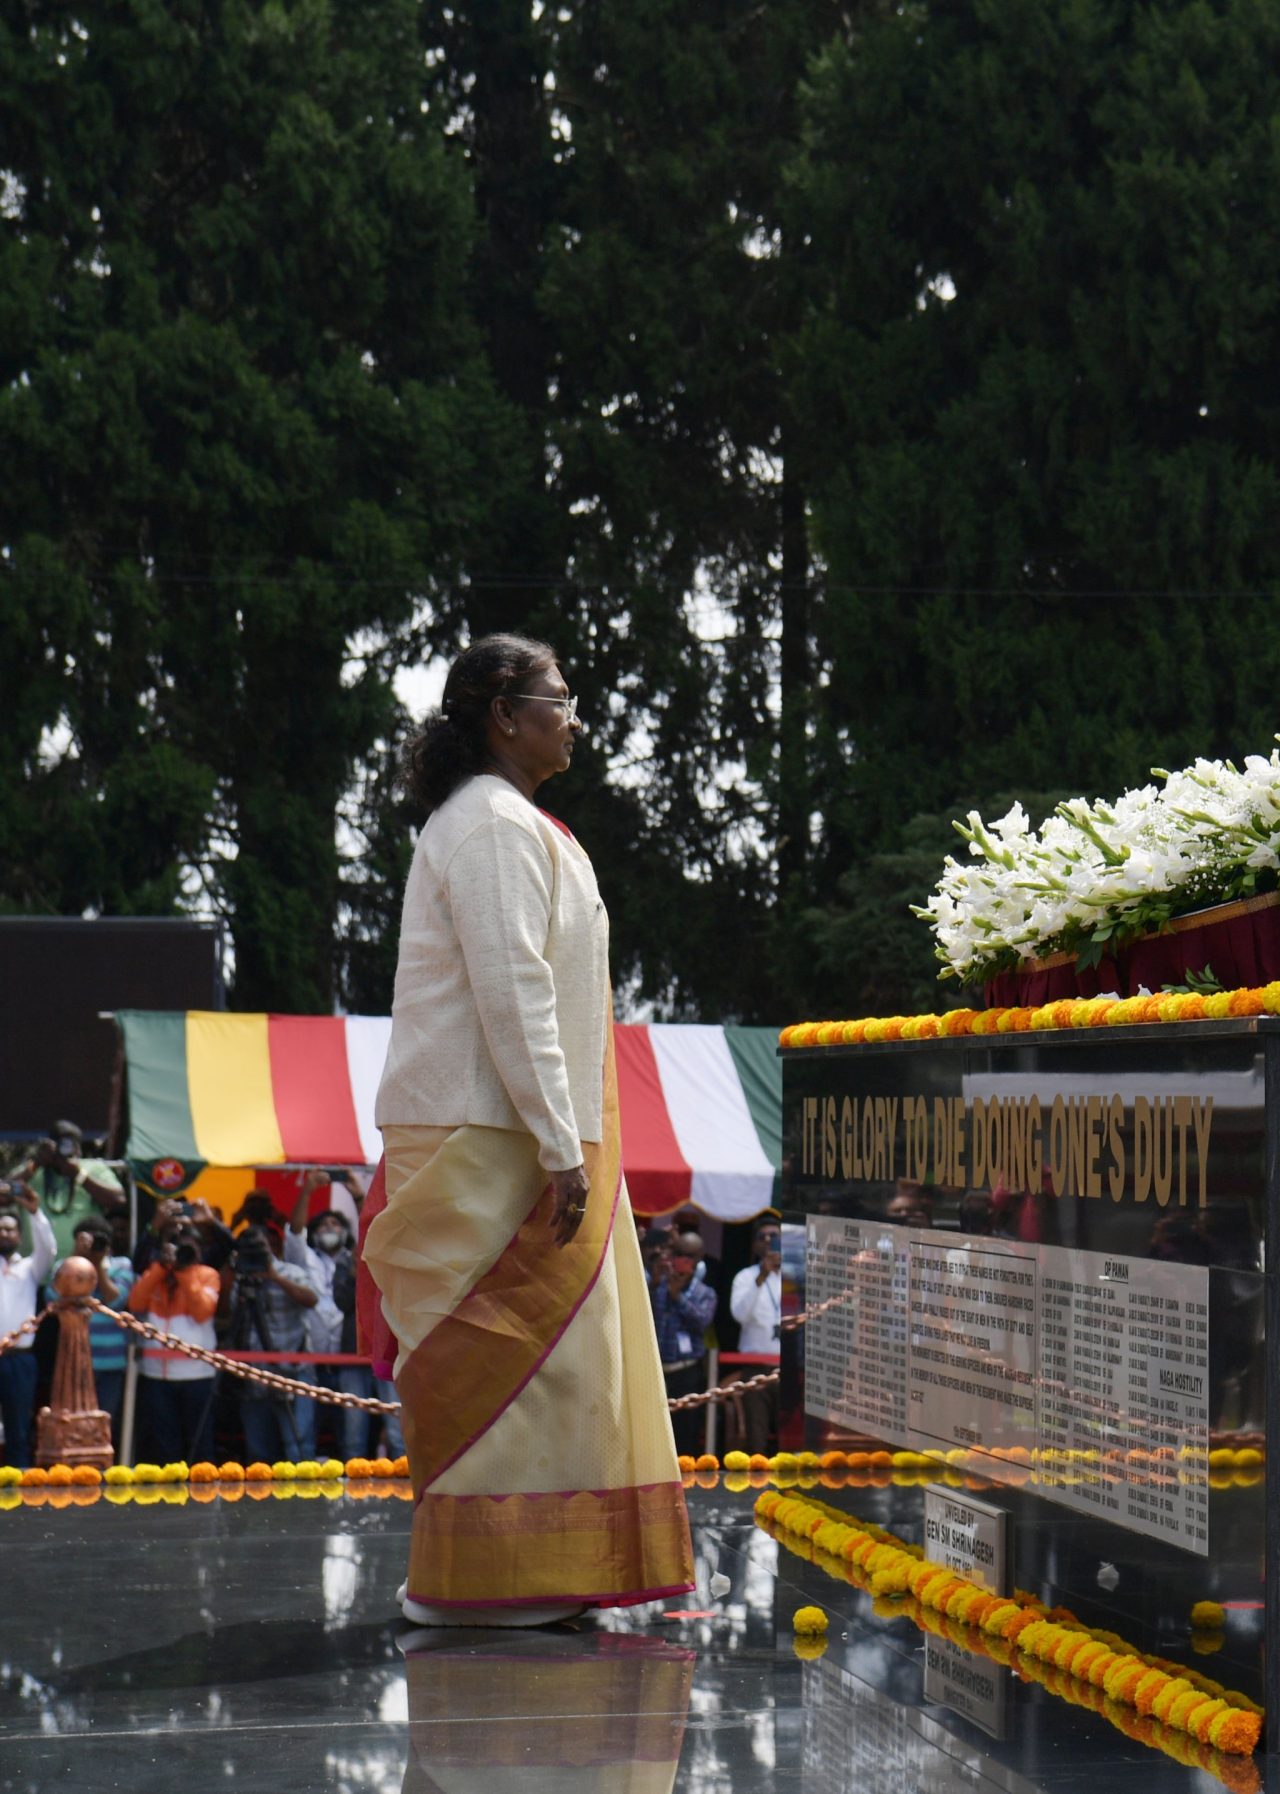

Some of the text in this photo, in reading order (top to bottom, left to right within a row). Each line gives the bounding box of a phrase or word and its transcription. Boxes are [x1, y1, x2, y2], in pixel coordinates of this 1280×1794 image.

[804, 1093, 1213, 1208] IT IS GLORY TO DIE DOING ONE'S DUTY
[1105, 1261, 1129, 1279] OP PAWAN
[1160, 1369, 1202, 1394] NAGA HOSTILITY
[945, 1503, 974, 1528] UNVEILED BY
[927, 1519, 994, 1566] GEN SM SHRINAGESH
